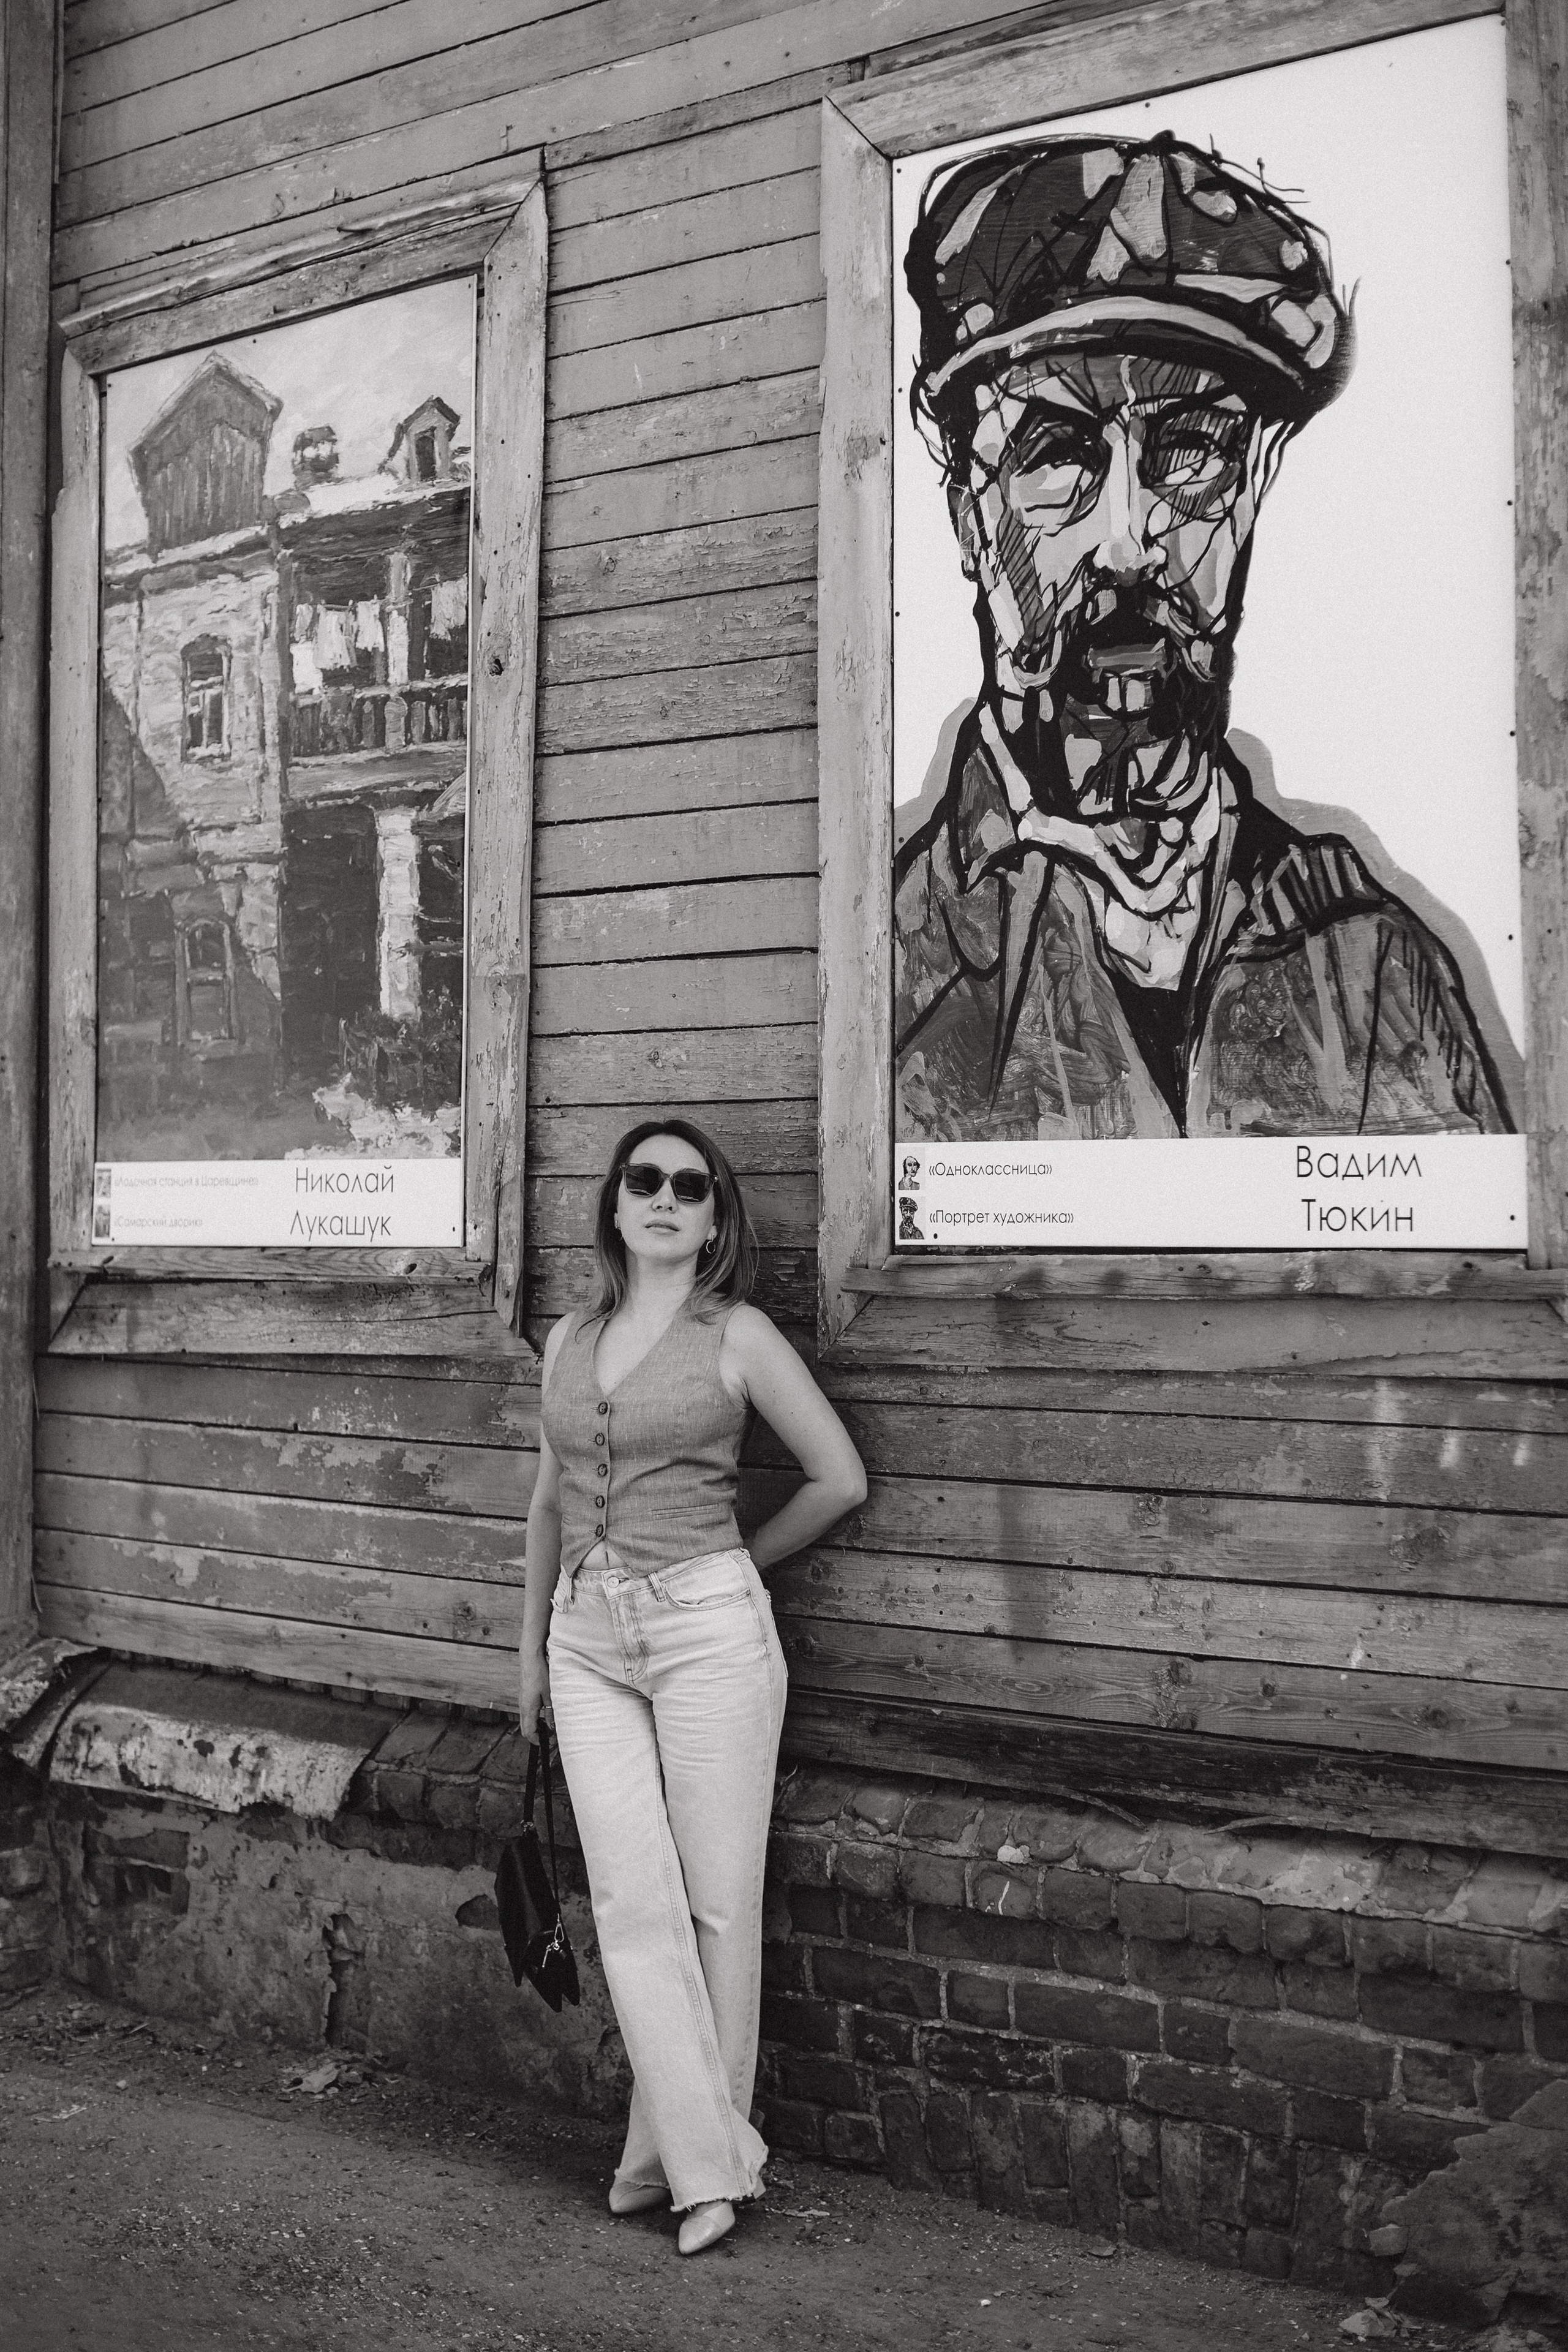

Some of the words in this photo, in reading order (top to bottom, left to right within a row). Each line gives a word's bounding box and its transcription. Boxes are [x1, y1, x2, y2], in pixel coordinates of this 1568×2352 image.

[929, 1161, 1053, 1177] «Одноклассница»
[1297, 1145, 1422, 1180] Вадим
[295, 1165, 394, 1193] Николай
[290, 1210, 391, 1243] Лукашук
[929, 1210, 990, 1227] «Портрет
[993, 1212, 1075, 1227] художника»
[1301, 1199, 1414, 1232] Тюкин
